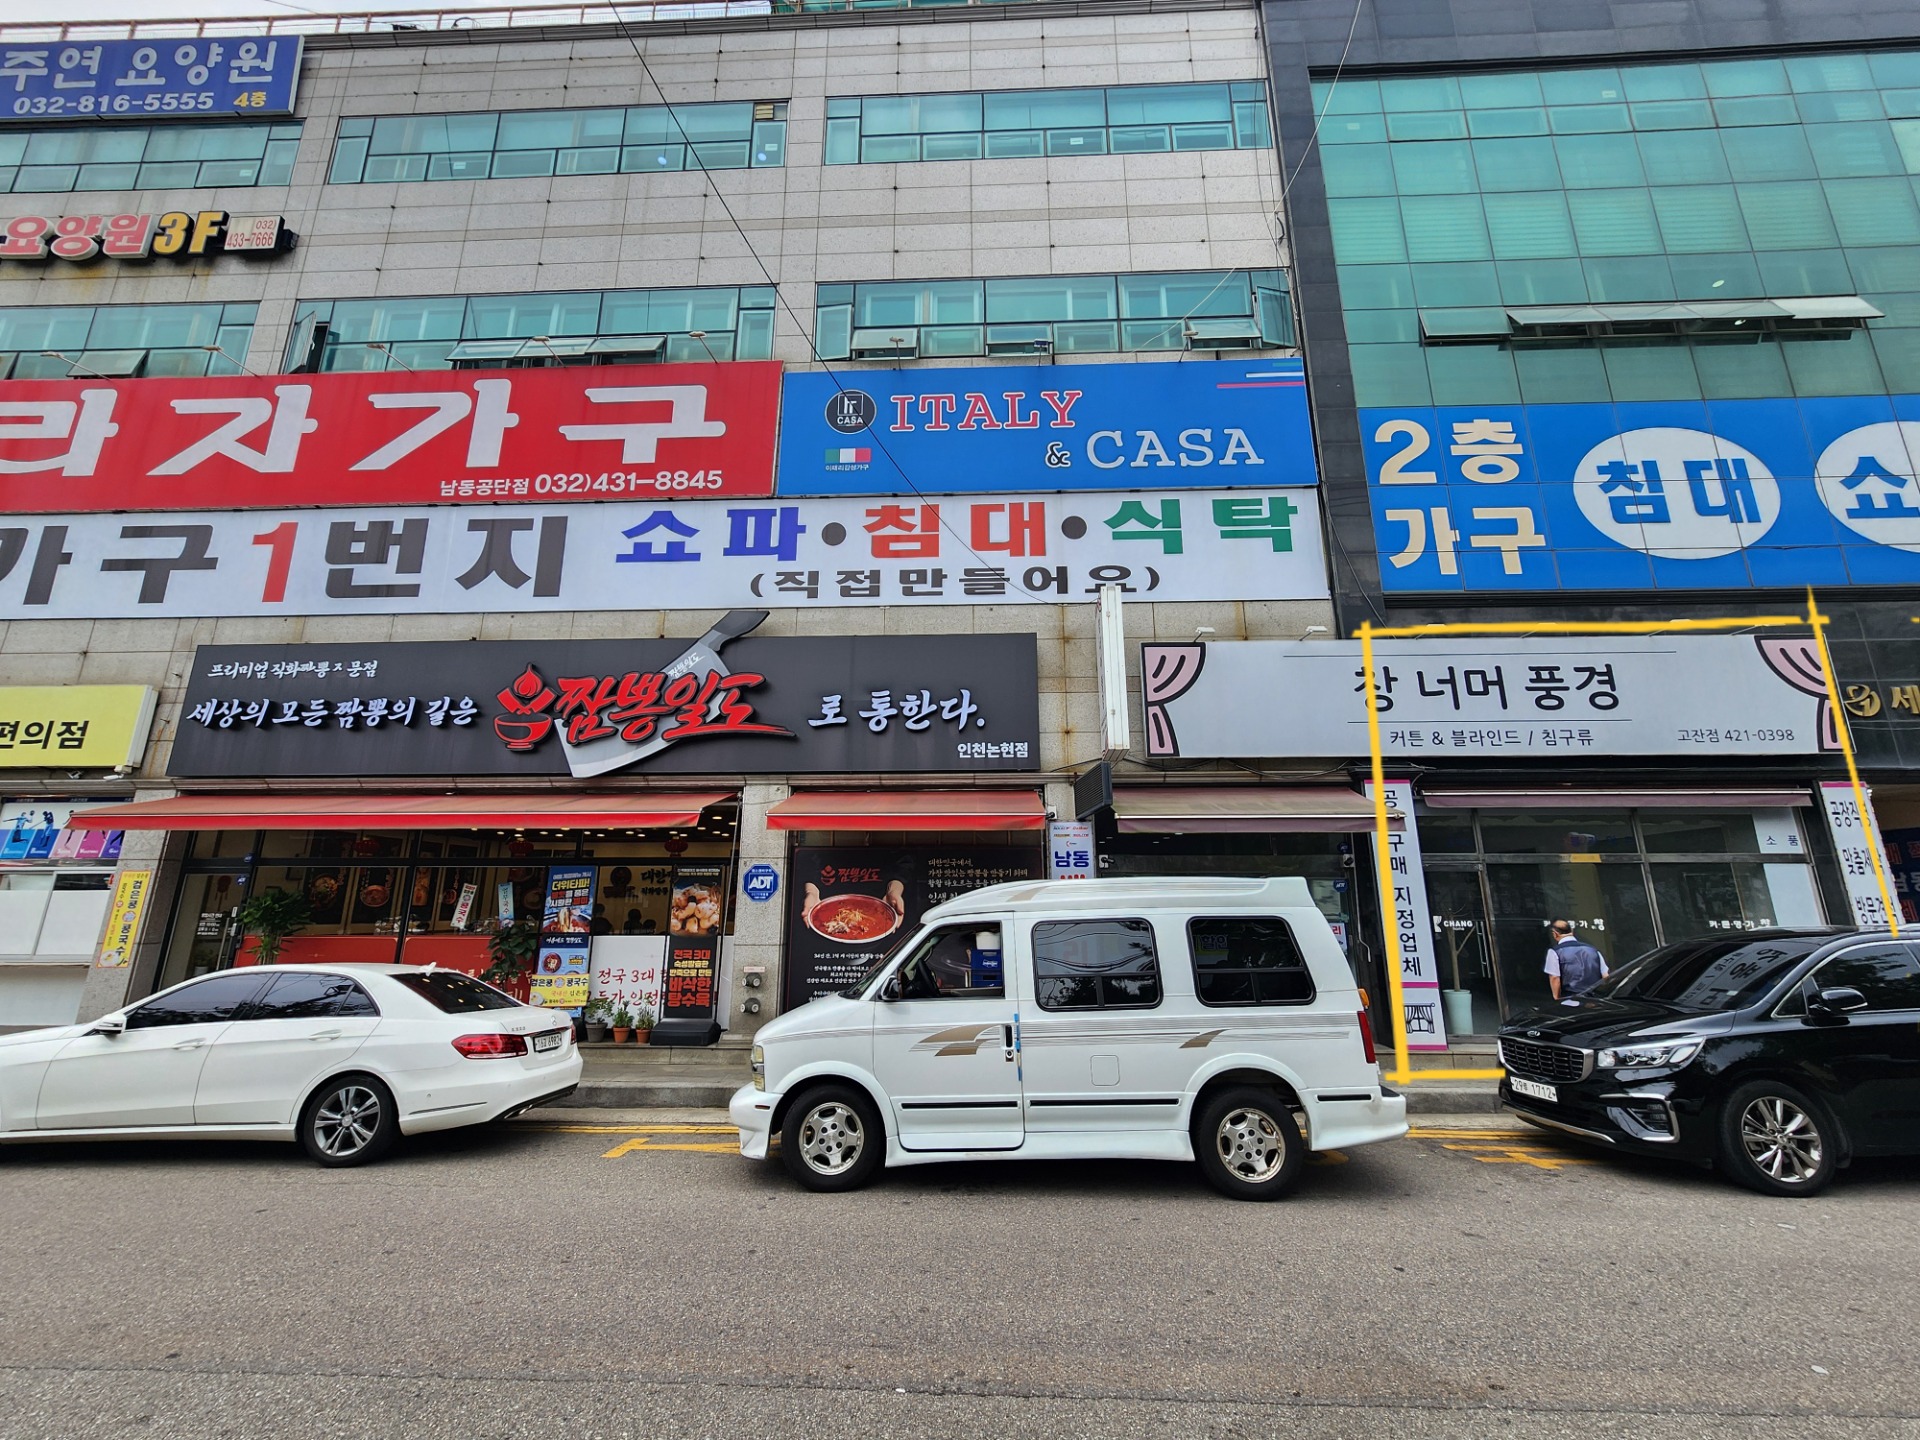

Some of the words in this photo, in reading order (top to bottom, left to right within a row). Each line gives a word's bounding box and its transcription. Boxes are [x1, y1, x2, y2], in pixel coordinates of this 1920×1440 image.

[0, 46, 102, 91] 주연
[115, 41, 277, 86] 요양원
[13, 92, 214, 114] 032-816-5555
[233, 91, 266, 108] 4층
[153, 211, 228, 254] 3F
[255, 219, 277, 232] 032)
[226, 231, 275, 249] 433-7666
[837, 416, 863, 424] CASA
[890, 390, 1082, 433] ITALY
[1044, 441, 1071, 469] &
[1086, 428, 1263, 469] CASA
[1374, 418, 1524, 485] 2층
[440, 476, 530, 497] 남동공단점
[534, 469, 724, 495] 032)431-8845
[1596, 458, 1762, 524] 침대
[1385, 506, 1546, 576] 가구
[207, 661, 269, 679] 프리미엄
[1416, 665, 1508, 710] 너머
[1525, 663, 1620, 711] 풍경
[187, 697, 271, 728] 세상의
[272, 698, 328, 727] 모든
[333, 696, 414, 729] 짬뽕의
[556, 669, 797, 745] 짬뽕일도
[807, 694, 847, 727] 로
[858, 688, 986, 733] 통한다.
[1389, 729, 1424, 747] 커튼
[1432, 731, 1445, 746] &
[1451, 729, 1522, 747] 블라인드
[1542, 729, 1594, 747] 침구류
[1678, 728, 1720, 743] 고잔점
[1724, 728, 1795, 743] 421-0398
[957, 741, 1029, 759] 인천논현점
[1055, 850, 1089, 867] 남동
[749, 876, 773, 889] ADT
[1393, 886, 1422, 977] 지정업체
[1443, 920, 1473, 928] CHANG
[598, 968, 627, 985] 전국
[669, 977, 711, 992] 바삭한
[1531, 1084, 1553, 1099] 1712
